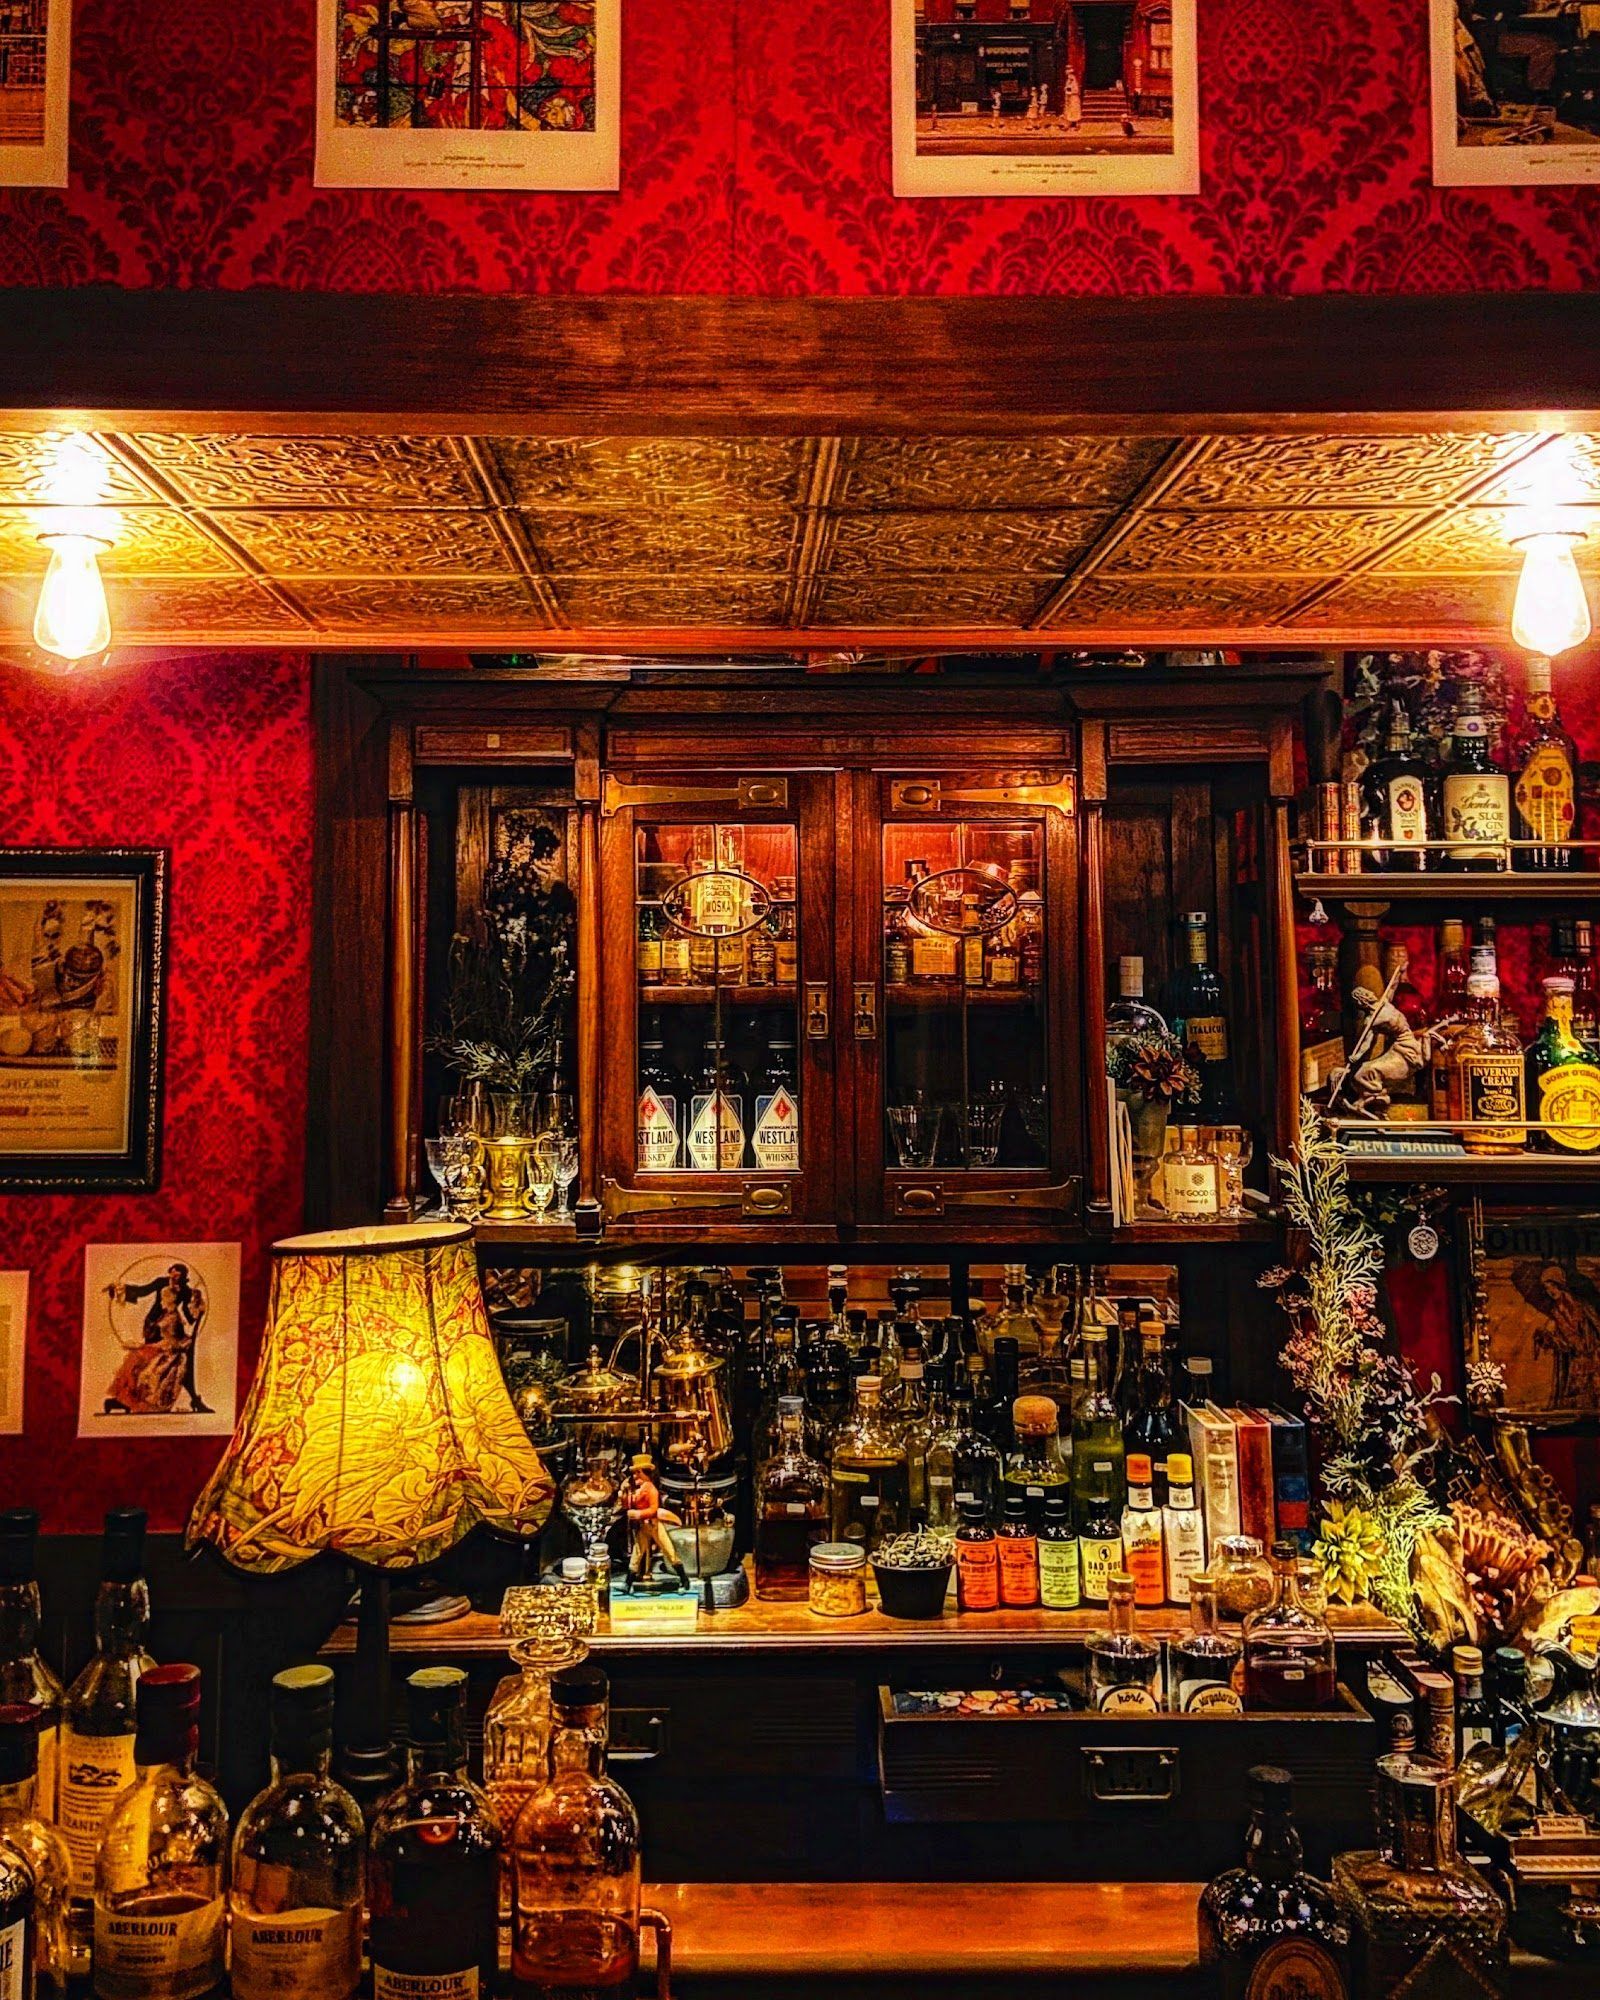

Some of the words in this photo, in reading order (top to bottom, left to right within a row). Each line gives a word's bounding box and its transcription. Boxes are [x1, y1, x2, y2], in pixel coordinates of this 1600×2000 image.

[1478, 812, 1504, 820] SLOE
[1486, 821, 1504, 830] GIN
[1472, 1066, 1520, 1077] INVERNESS
[1481, 1076, 1513, 1086] CREAM
[1546, 1070, 1569, 1085] JOHN
[638, 1130, 673, 1145] STLAND
[759, 1130, 799, 1145] WESTLA
[1400, 1142, 1457, 1153] MARTIN
[638, 1153, 667, 1161] HISKEY
[701, 1153, 736, 1161] WHIKEY
[1186, 1189, 1208, 1197] GOOD
[108, 1921, 178, 1937] ABERLOUR
[251, 1928, 323, 1945] ABERLOUR
[383, 1975, 467, 1994] ABERLOUR
